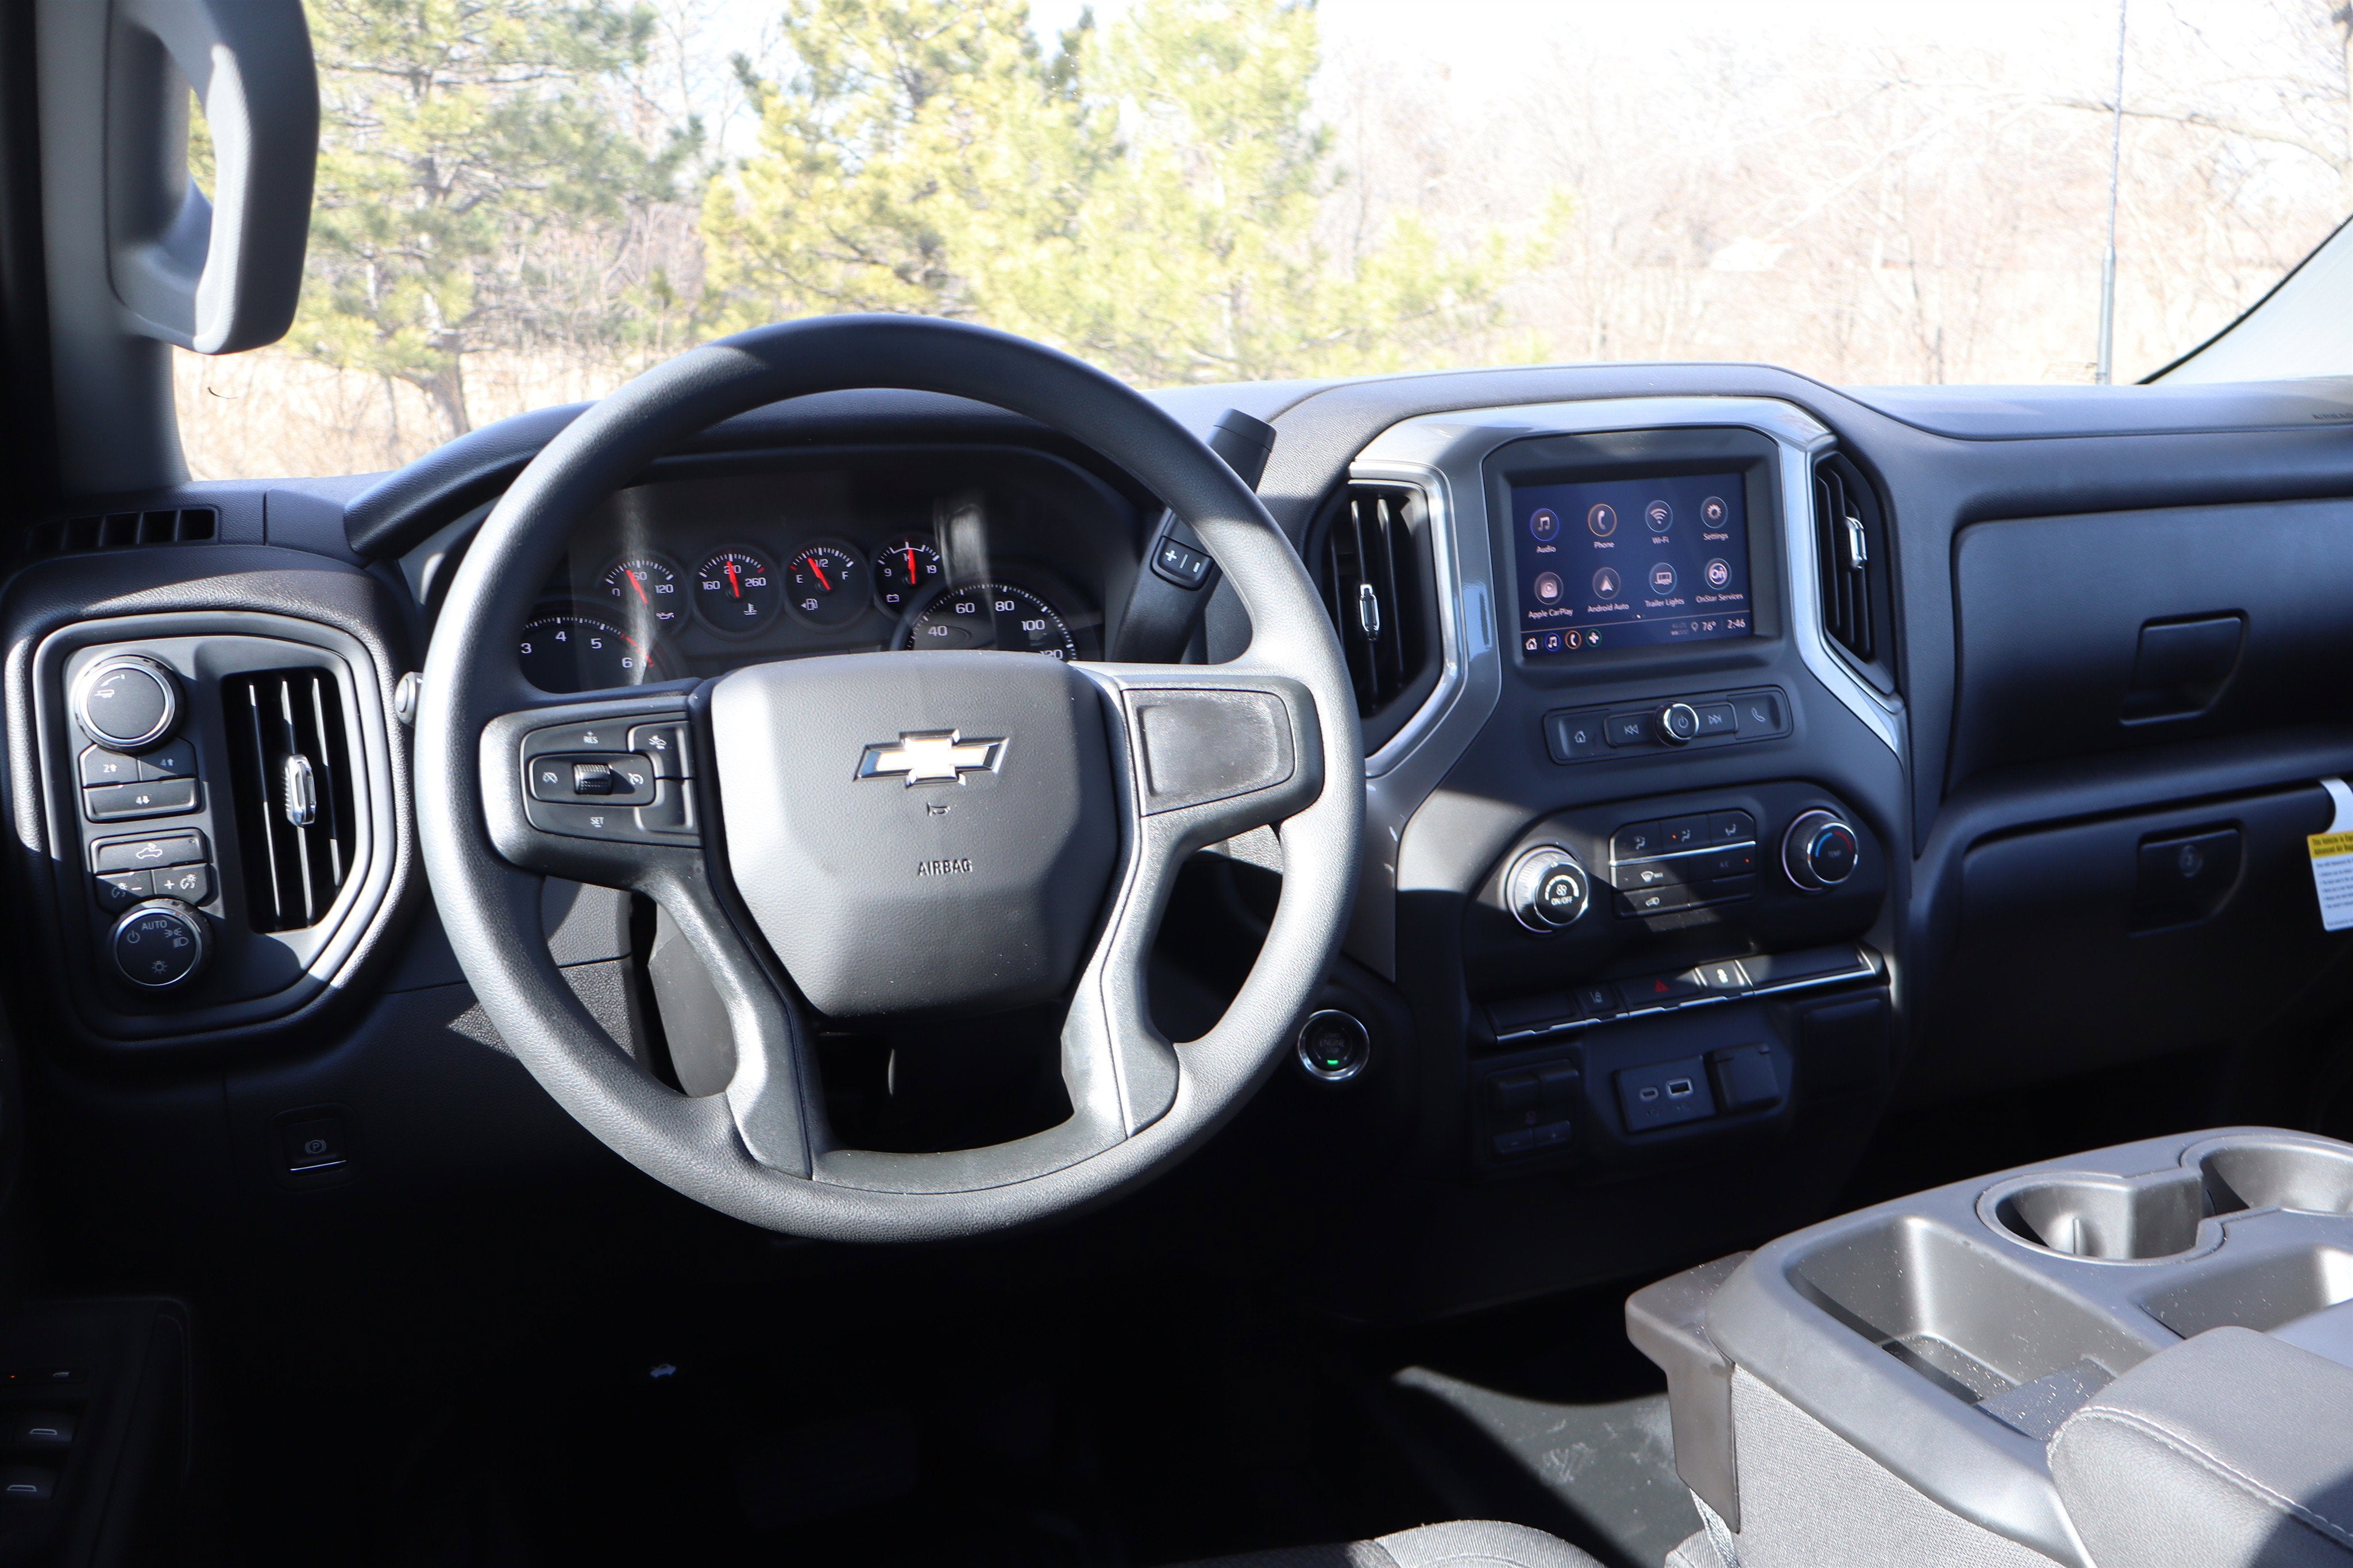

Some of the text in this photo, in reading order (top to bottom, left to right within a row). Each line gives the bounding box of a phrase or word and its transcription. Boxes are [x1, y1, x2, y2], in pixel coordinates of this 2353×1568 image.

[1536, 544, 1556, 553] Audio
[724, 565, 742, 574] 20
[885, 568, 892, 577] 9
[925, 565, 937, 573] 19
[796, 574, 803, 583] E
[842, 571, 849, 580] F
[702, 581, 720, 590] 160
[745, 577, 766, 587] 260
[655, 584, 674, 593] 120
[955, 603, 975, 613] 60
[994, 600, 1015, 612] 80
[1587, 604, 1613, 613] Android
[1528, 610, 1548, 620] Apple
[1021, 619, 1046, 631] 100
[1727, 619, 1746, 629] 2:46
[928, 625, 948, 636] 40
[555, 631, 567, 642] 4
[520, 643, 532, 654] 3
[591, 638, 602, 649] 5
[622, 657, 633, 668] 6
[584, 736, 599, 744] RES
[590, 816, 604, 824] SET
[919, 859, 973, 876] AIRBAG
[1551, 896, 1573, 906] ON/OFF
[141, 920, 168, 930] AUTO
